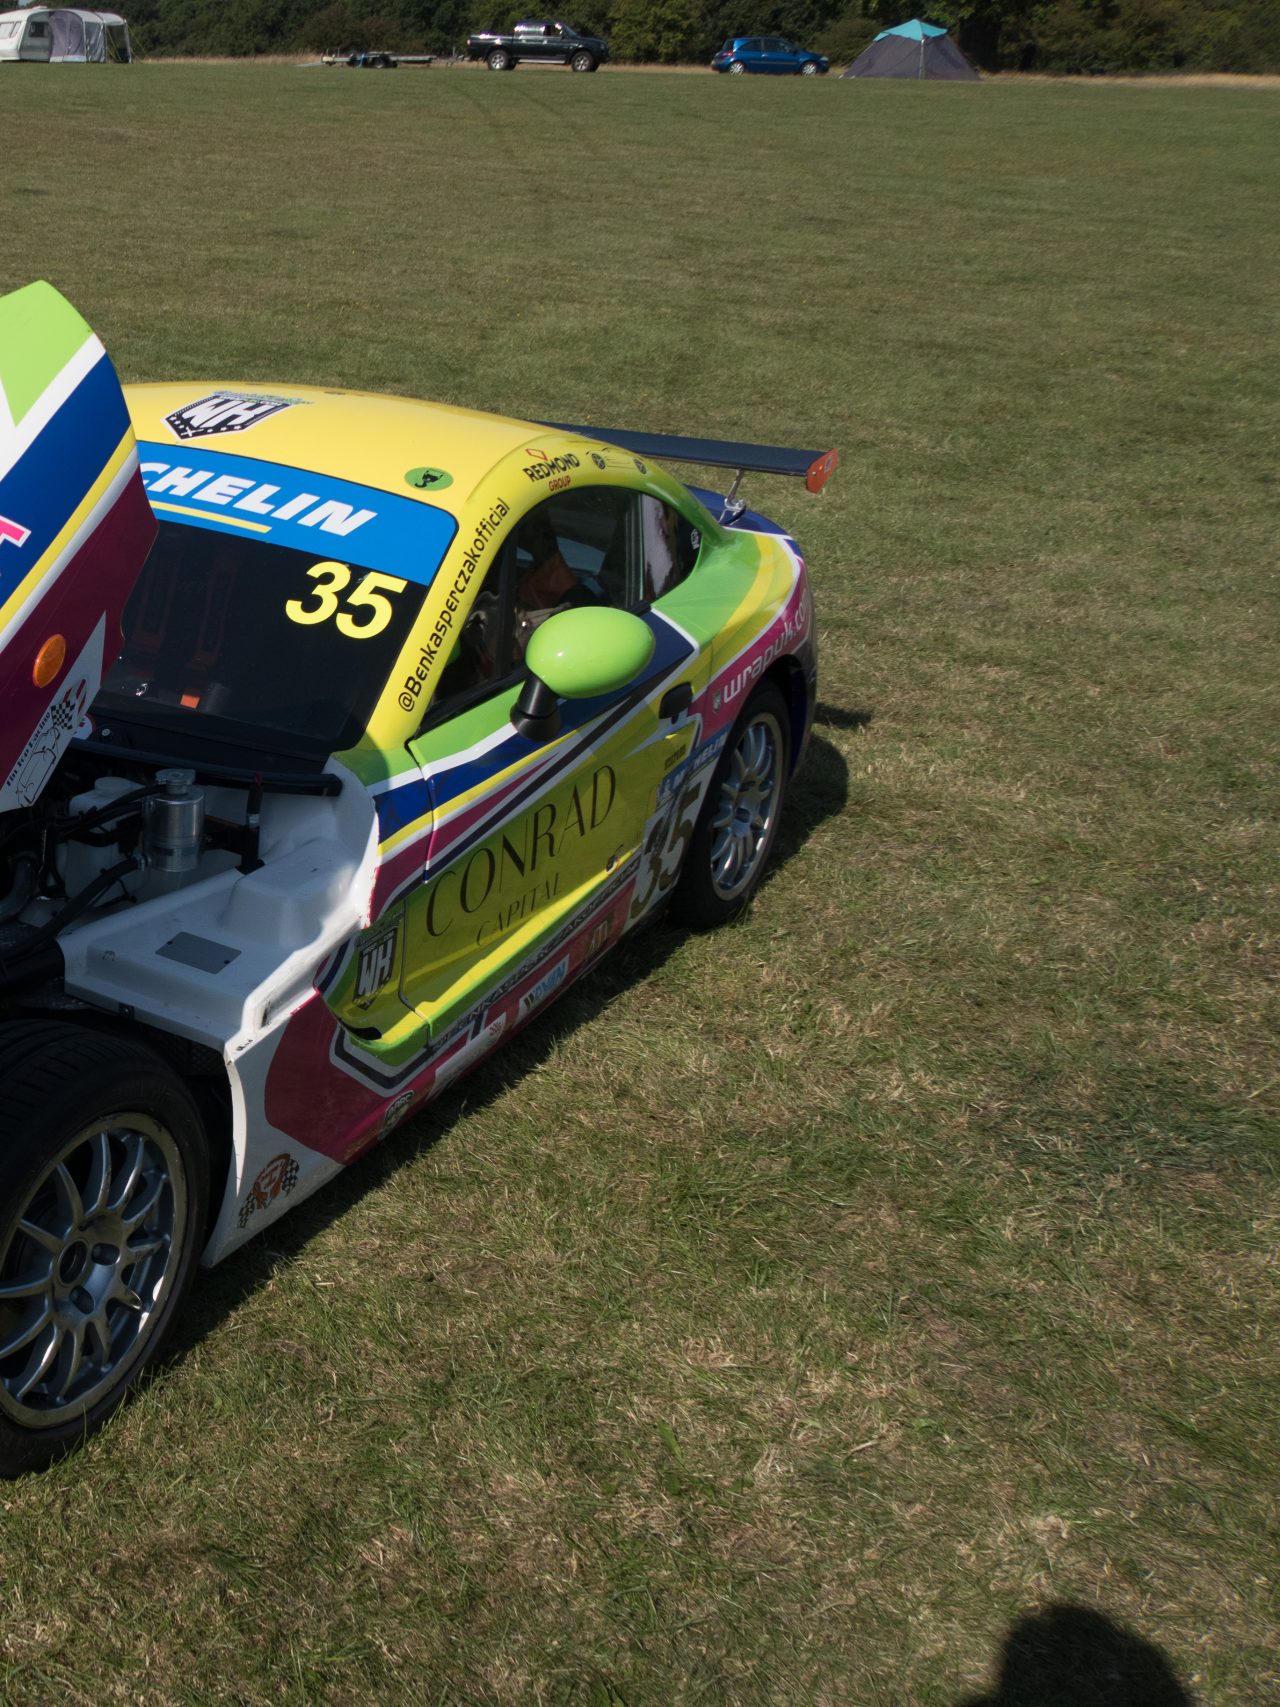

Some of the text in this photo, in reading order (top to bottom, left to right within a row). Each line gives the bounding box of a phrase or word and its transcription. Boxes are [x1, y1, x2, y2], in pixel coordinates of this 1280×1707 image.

[523, 453, 580, 483] REDMOND
[548, 474, 572, 492] GROUP
[285, 560, 409, 640] 35
[426, 765, 616, 938] CONRAD
[476, 872, 561, 947] CAPITAL
